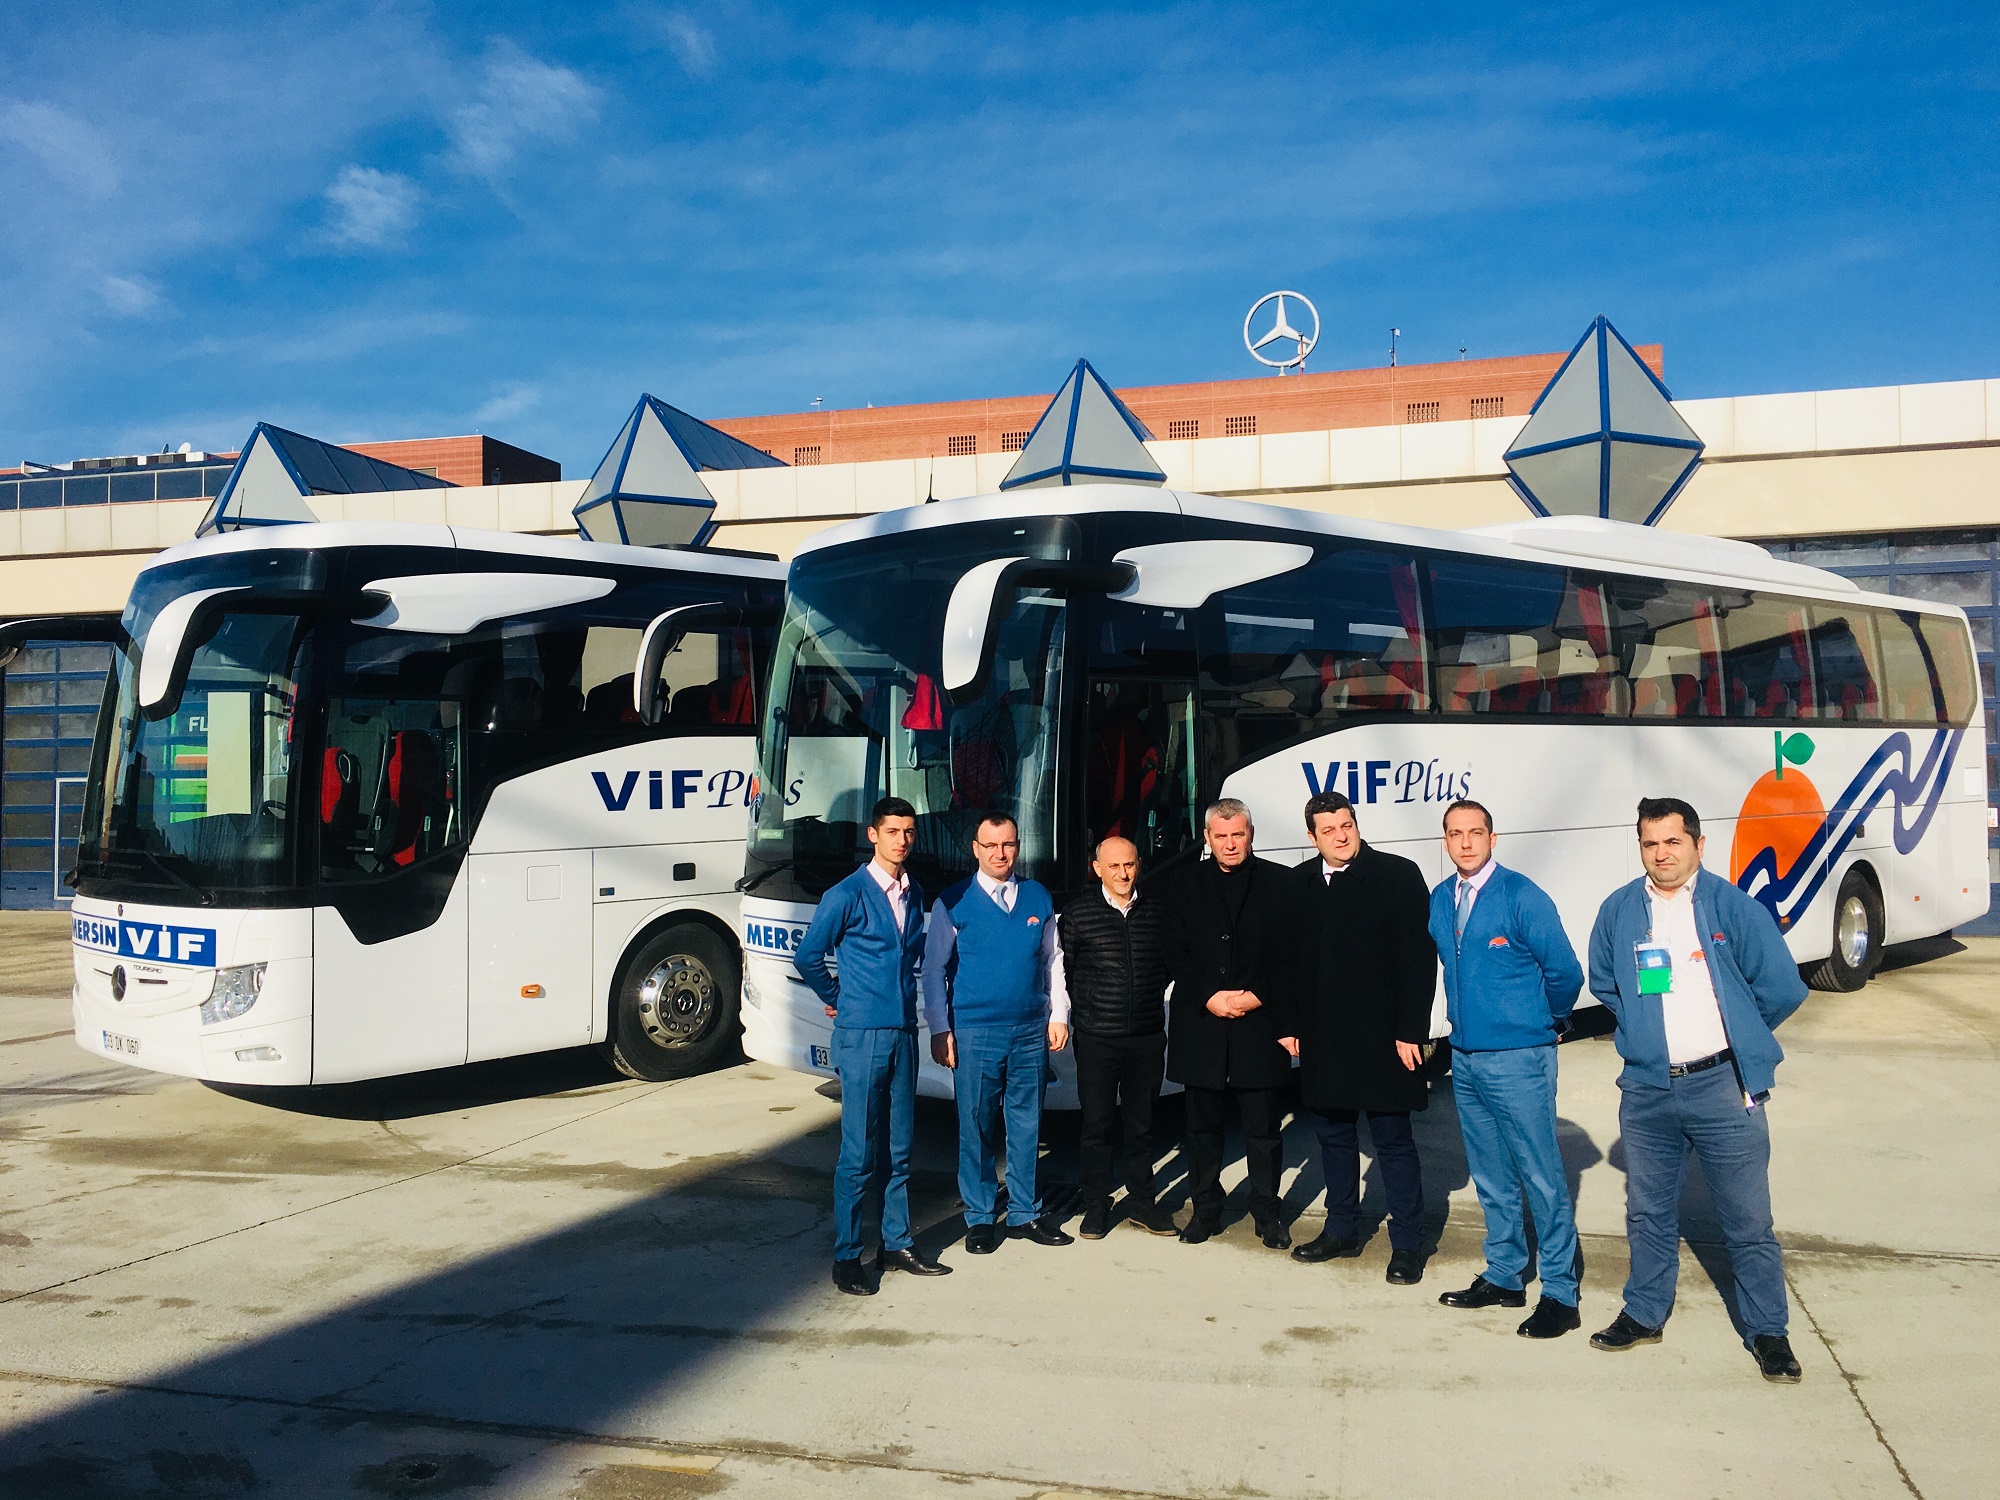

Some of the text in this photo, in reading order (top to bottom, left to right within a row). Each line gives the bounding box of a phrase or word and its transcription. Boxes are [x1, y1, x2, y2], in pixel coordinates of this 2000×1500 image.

[707, 768, 804, 808] Pls
[1394, 758, 1472, 804] Plus
[747, 923, 835, 956] MERS
[133, 964, 163, 974] TOURISMO
[816, 1048, 828, 1066] 33
